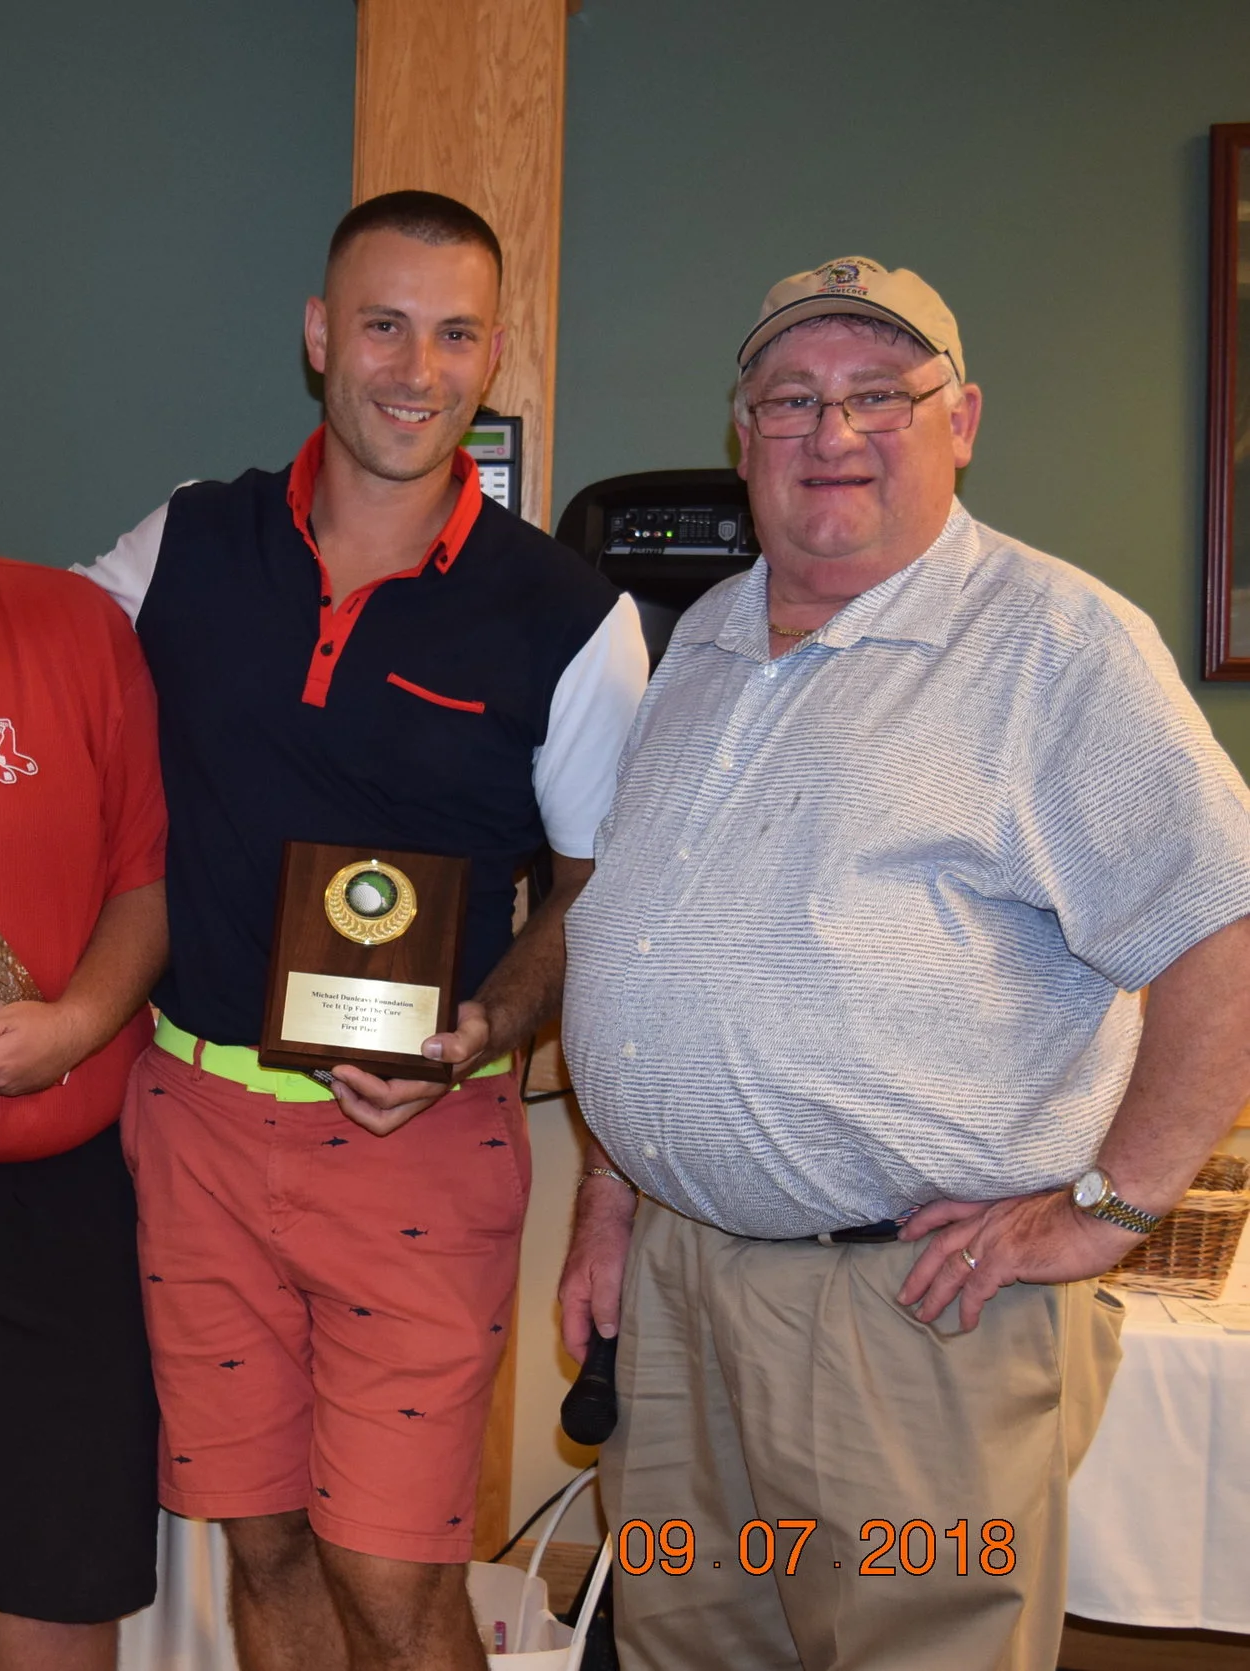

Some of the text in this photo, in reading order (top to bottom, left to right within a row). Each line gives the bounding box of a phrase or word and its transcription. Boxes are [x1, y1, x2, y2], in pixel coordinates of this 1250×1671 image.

[311, 991, 339, 1000] Michael
[322, 1002, 334, 1010] Tee
[343, 1004, 353, 1012] Up
[355, 1005, 367, 1013] For
[383, 1008, 402, 1016] Cure
[343, 1014, 359, 1022] Sept
[341, 1023, 358, 1032] First
